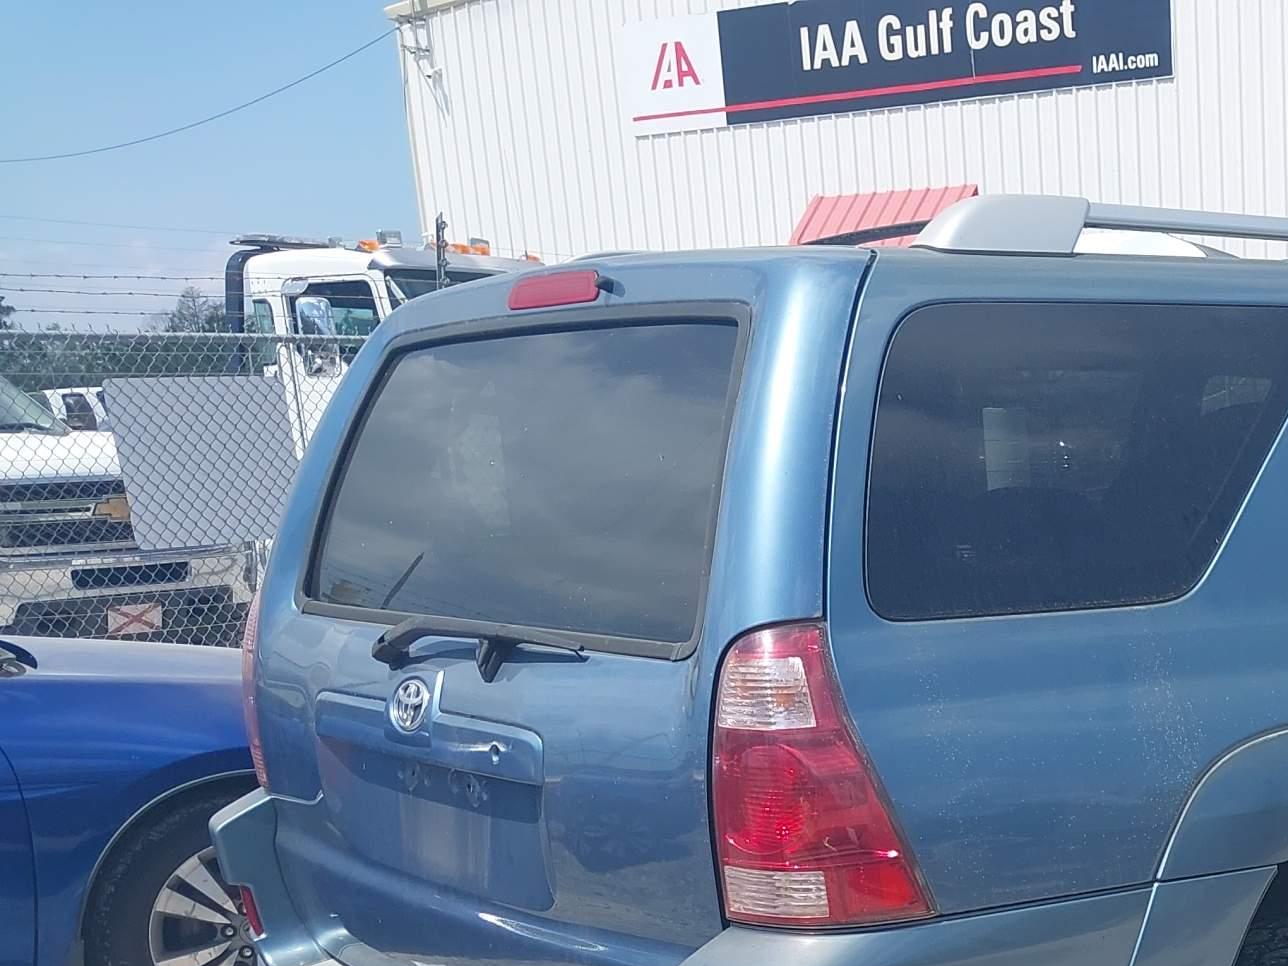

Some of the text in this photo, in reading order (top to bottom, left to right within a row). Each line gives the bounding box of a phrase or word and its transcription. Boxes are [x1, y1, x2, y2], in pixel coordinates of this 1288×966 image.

[799, 0, 1077, 71] IAA Gulf Coast
[1092, 52, 1159, 74] IAAI.com
